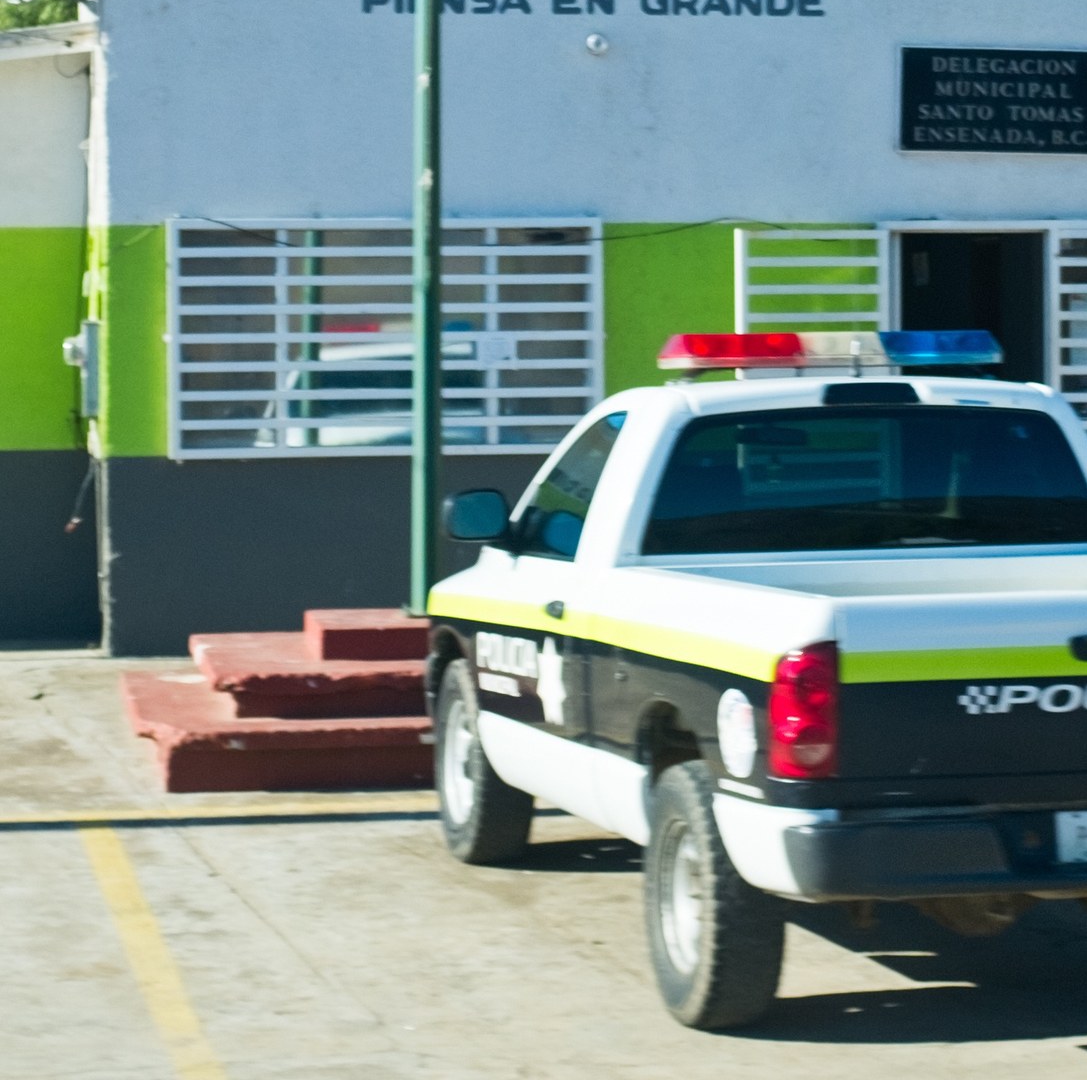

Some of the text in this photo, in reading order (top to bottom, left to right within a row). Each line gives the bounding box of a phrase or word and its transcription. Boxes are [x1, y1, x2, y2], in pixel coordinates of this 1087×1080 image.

[931, 56, 1077, 75] DELEGACION
[934, 80, 1074, 99] MUNICIPAL
[917, 103, 1085, 123] SANTO TOMAS
